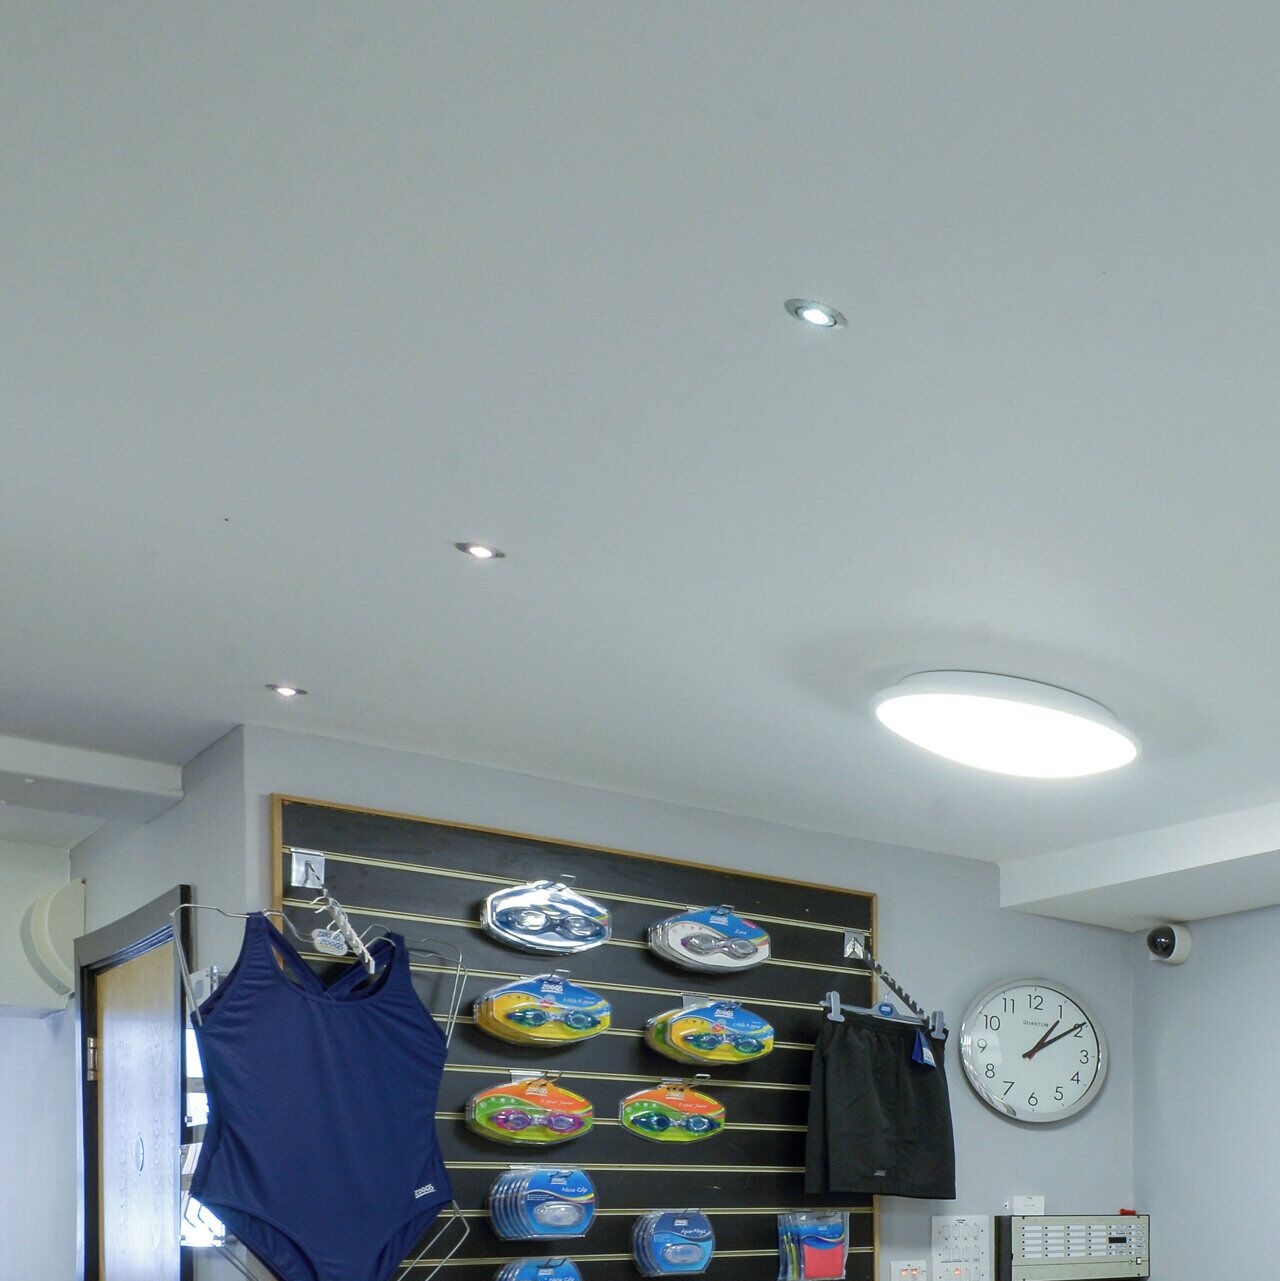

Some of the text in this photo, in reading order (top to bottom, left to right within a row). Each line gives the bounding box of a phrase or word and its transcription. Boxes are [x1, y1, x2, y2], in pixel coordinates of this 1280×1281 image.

[1002, 997, 1015, 1014] 11
[1027, 994, 1044, 1011] 12
[1058, 1004, 1063, 1020] 1
[983, 1014, 1001, 1031] 10
[1022, 1019, 1049, 1028] QUANTUM
[1073, 1023, 1084, 1038] 2
[977, 1039, 988, 1054] 9
[1079, 1049, 1089, 1065] 3
[985, 1063, 996, 1079] 8
[1071, 1071, 1081, 1085] 4
[1003, 1081, 1015, 1096] 7
[1053, 1086, 1064, 1101] 5
[1027, 1092, 1038, 1107] 6
